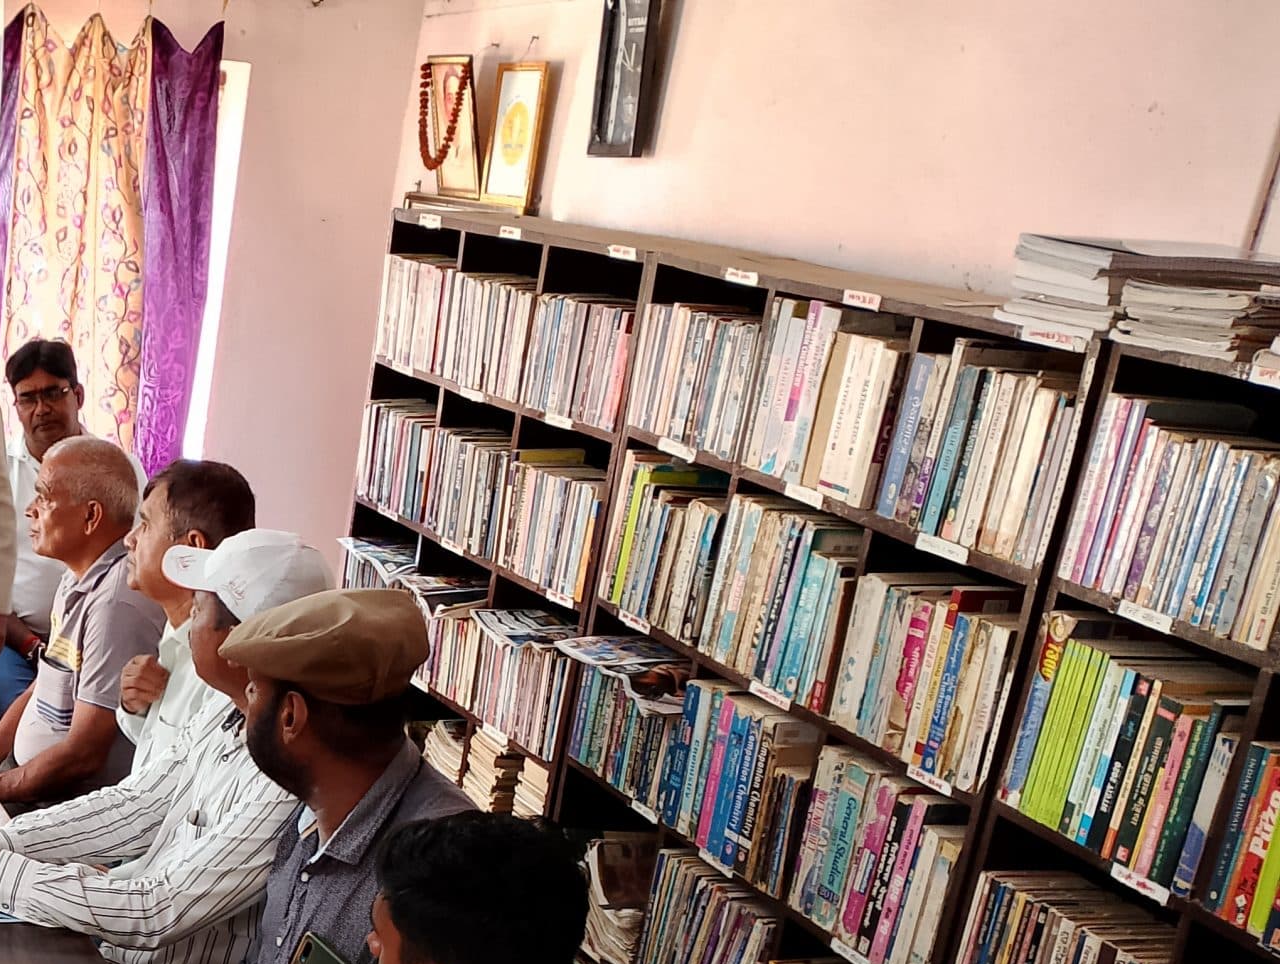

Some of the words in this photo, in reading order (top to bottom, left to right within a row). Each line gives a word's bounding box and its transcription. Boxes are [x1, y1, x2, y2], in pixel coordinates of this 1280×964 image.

[1241, 757, 1257, 790] INDIAN
[727, 782, 747, 831] Chemistry
[740, 790, 761, 837] Chemistry
[836, 797, 859, 845] General
[1228, 791, 1247, 832] RAILWAYS
[825, 843, 847, 888] Studies
